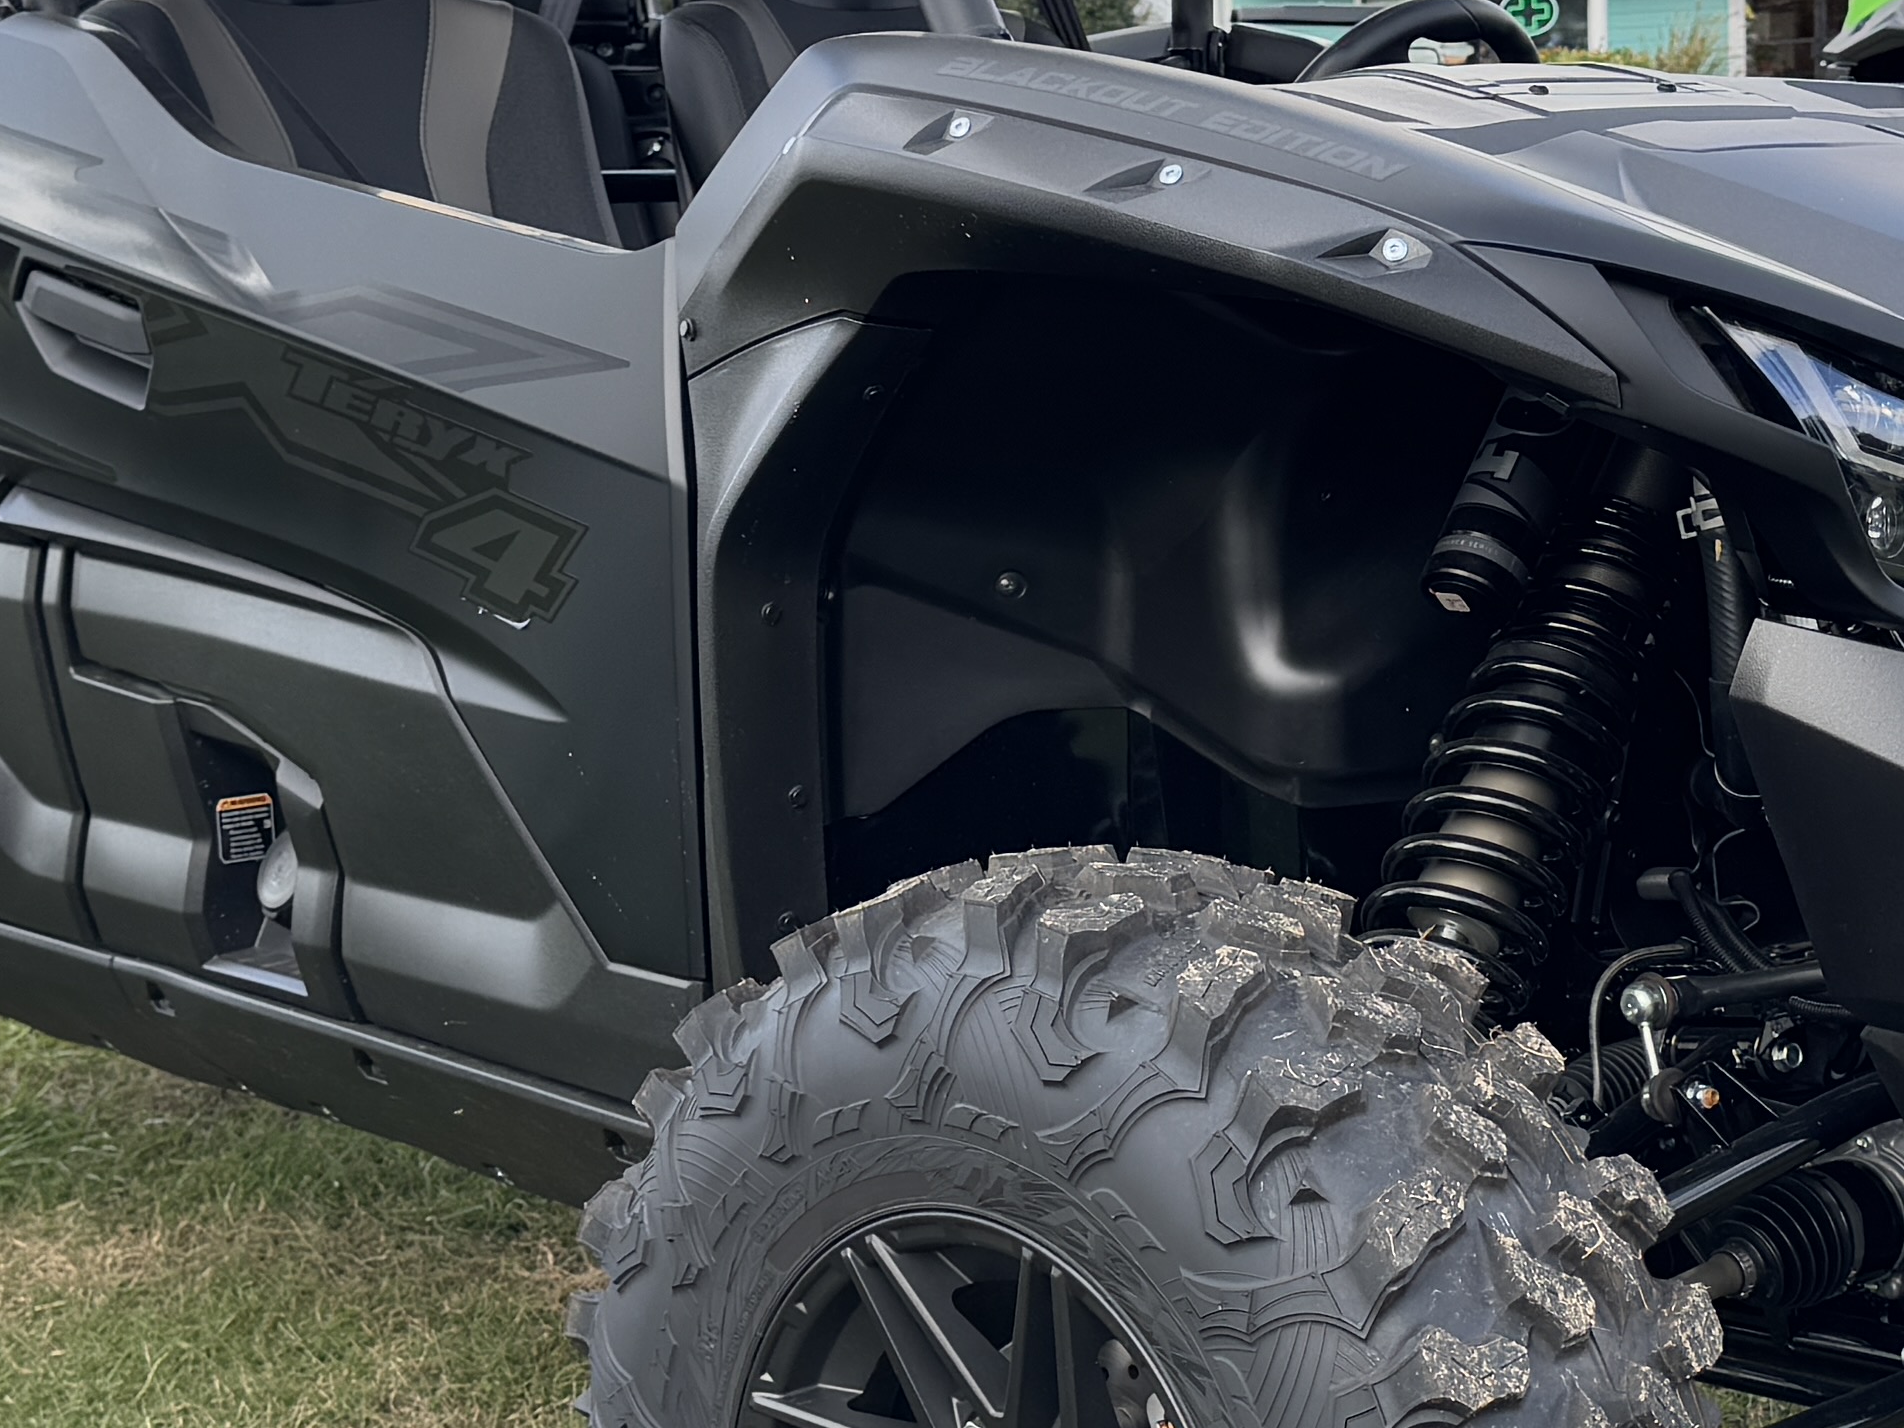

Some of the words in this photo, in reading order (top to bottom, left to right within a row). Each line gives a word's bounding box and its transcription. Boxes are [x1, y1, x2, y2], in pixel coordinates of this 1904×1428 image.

[943, 55, 1200, 119] BLACKOUT
[1202, 112, 1410, 182] EDITION
[282, 346, 530, 478] TERYX
